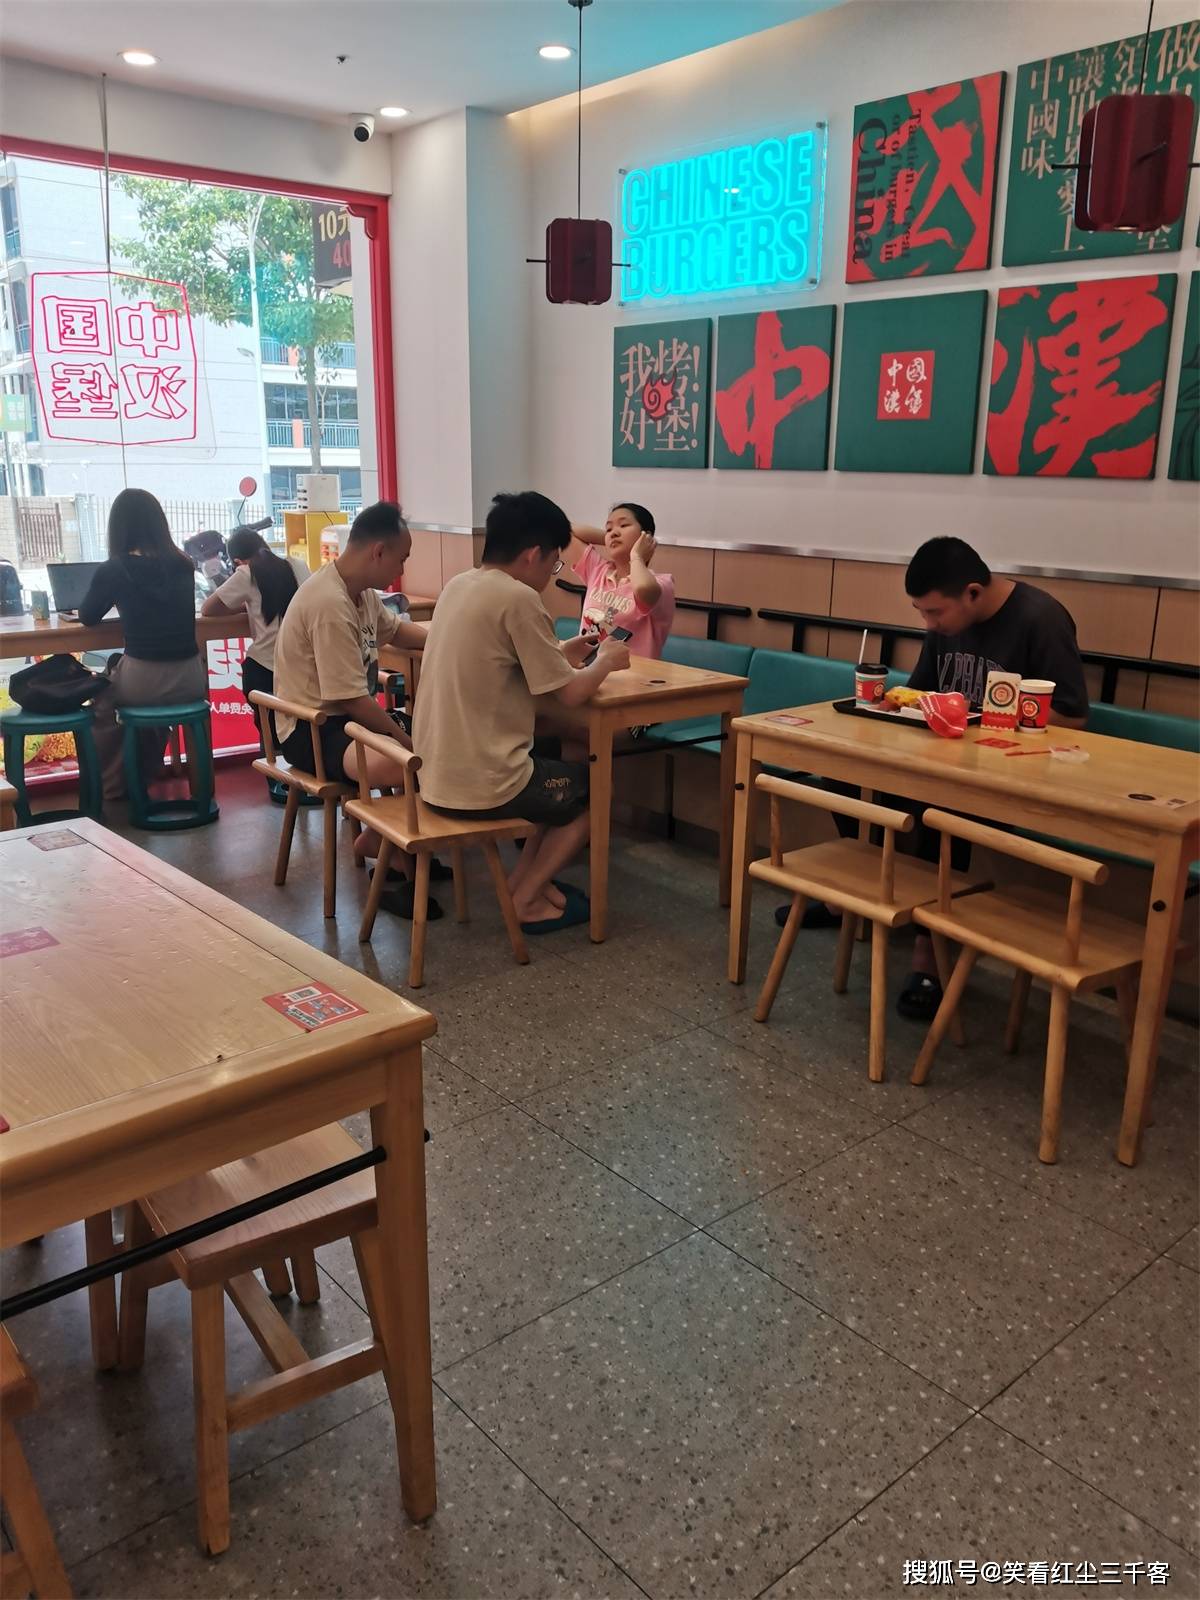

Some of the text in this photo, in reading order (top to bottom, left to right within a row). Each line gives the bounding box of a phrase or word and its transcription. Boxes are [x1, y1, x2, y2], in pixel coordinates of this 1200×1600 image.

[622, 130, 814, 235] CHINESE
[853, 117, 887, 265] China
[621, 209, 809, 301] BURGERS
